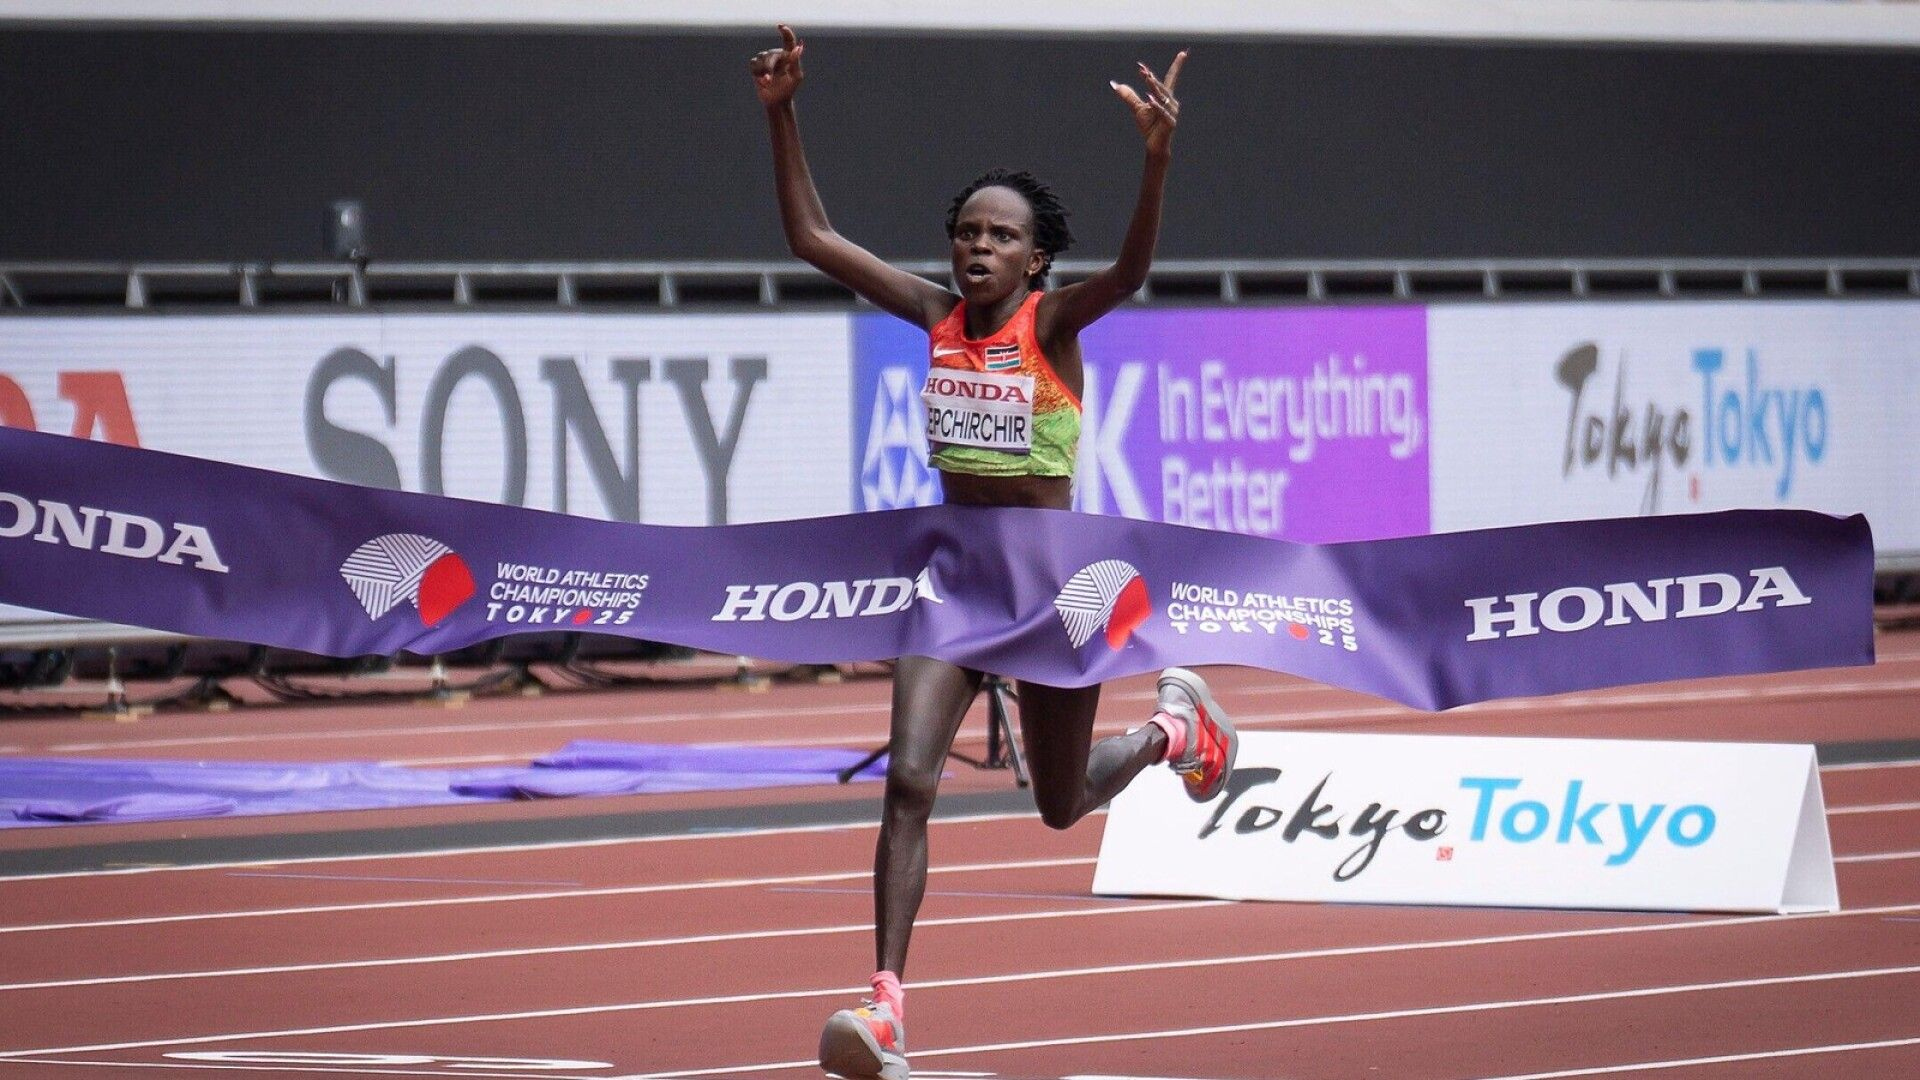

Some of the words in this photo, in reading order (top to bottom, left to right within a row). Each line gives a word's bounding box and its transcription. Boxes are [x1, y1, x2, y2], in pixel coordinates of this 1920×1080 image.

[924, 377, 1029, 404] HONDA
[1157, 361, 1196, 443] In
[1200, 353, 1422, 463] Everything,
[302, 346, 767, 527] SONY
[1553, 342, 1691, 516] Tokyo
[1690, 347, 1826, 505] Tokyo
[1161, 456, 1289, 536] Better
[490, 582, 642, 609] CHAMPIONSHIPS
[496, 563, 560, 585] WORLD
[560, 570, 649, 590] ATHLETICS
[1170, 582, 1239, 607] WORLD
[1242, 593, 1354, 616] ATHLETICS
[1464, 566, 1813, 642] HONDA
[1167, 603, 1355, 635] CHAMPIONSHIPS
[1197, 767, 1448, 882] Tokyo
[1459, 777, 1716, 867] Tokyo
